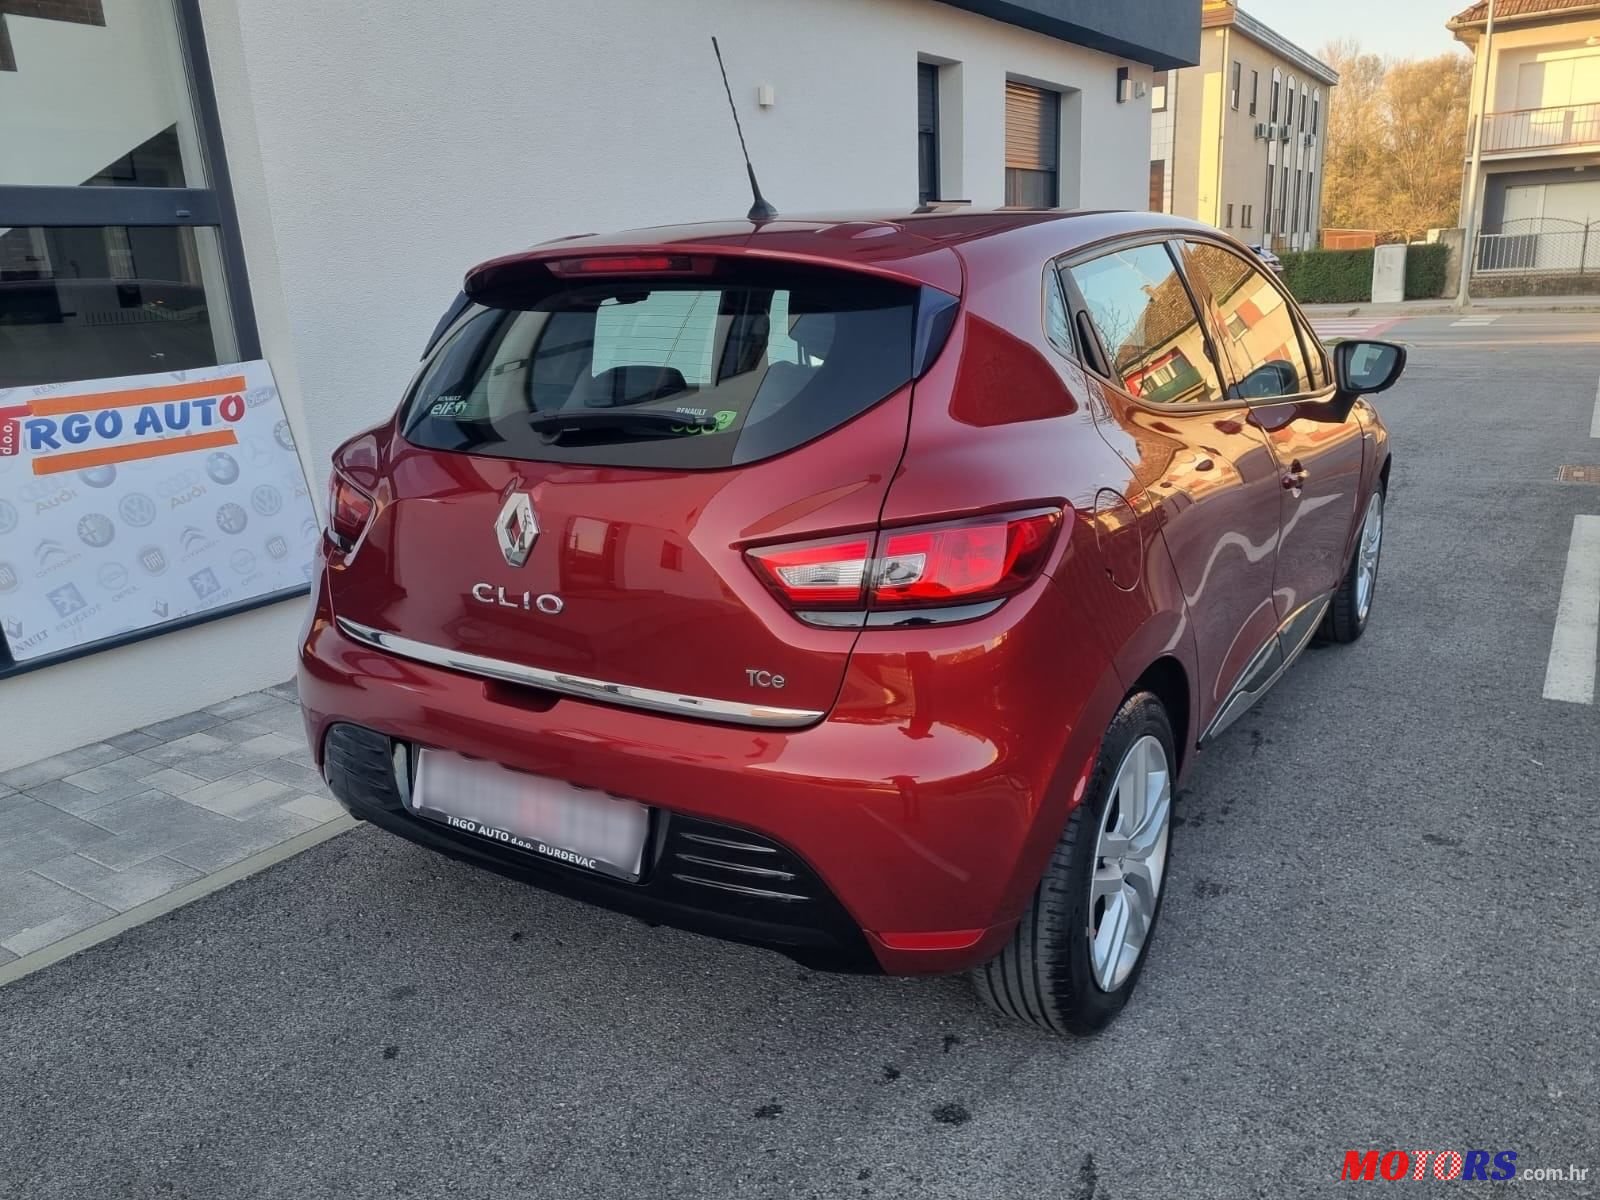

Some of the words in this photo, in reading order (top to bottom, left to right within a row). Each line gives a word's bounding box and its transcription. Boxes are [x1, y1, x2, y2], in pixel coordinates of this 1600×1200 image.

[133, 394, 246, 435] AUTO
[472, 583, 564, 614] CLIO
[746, 669, 785, 689] TCe
[447, 815, 476, 832] TRGO
[478, 825, 509, 842] AUTO
[511, 836, 534, 850] d.o.o.
[538, 843, 597, 869] ĐURĐEVAC
